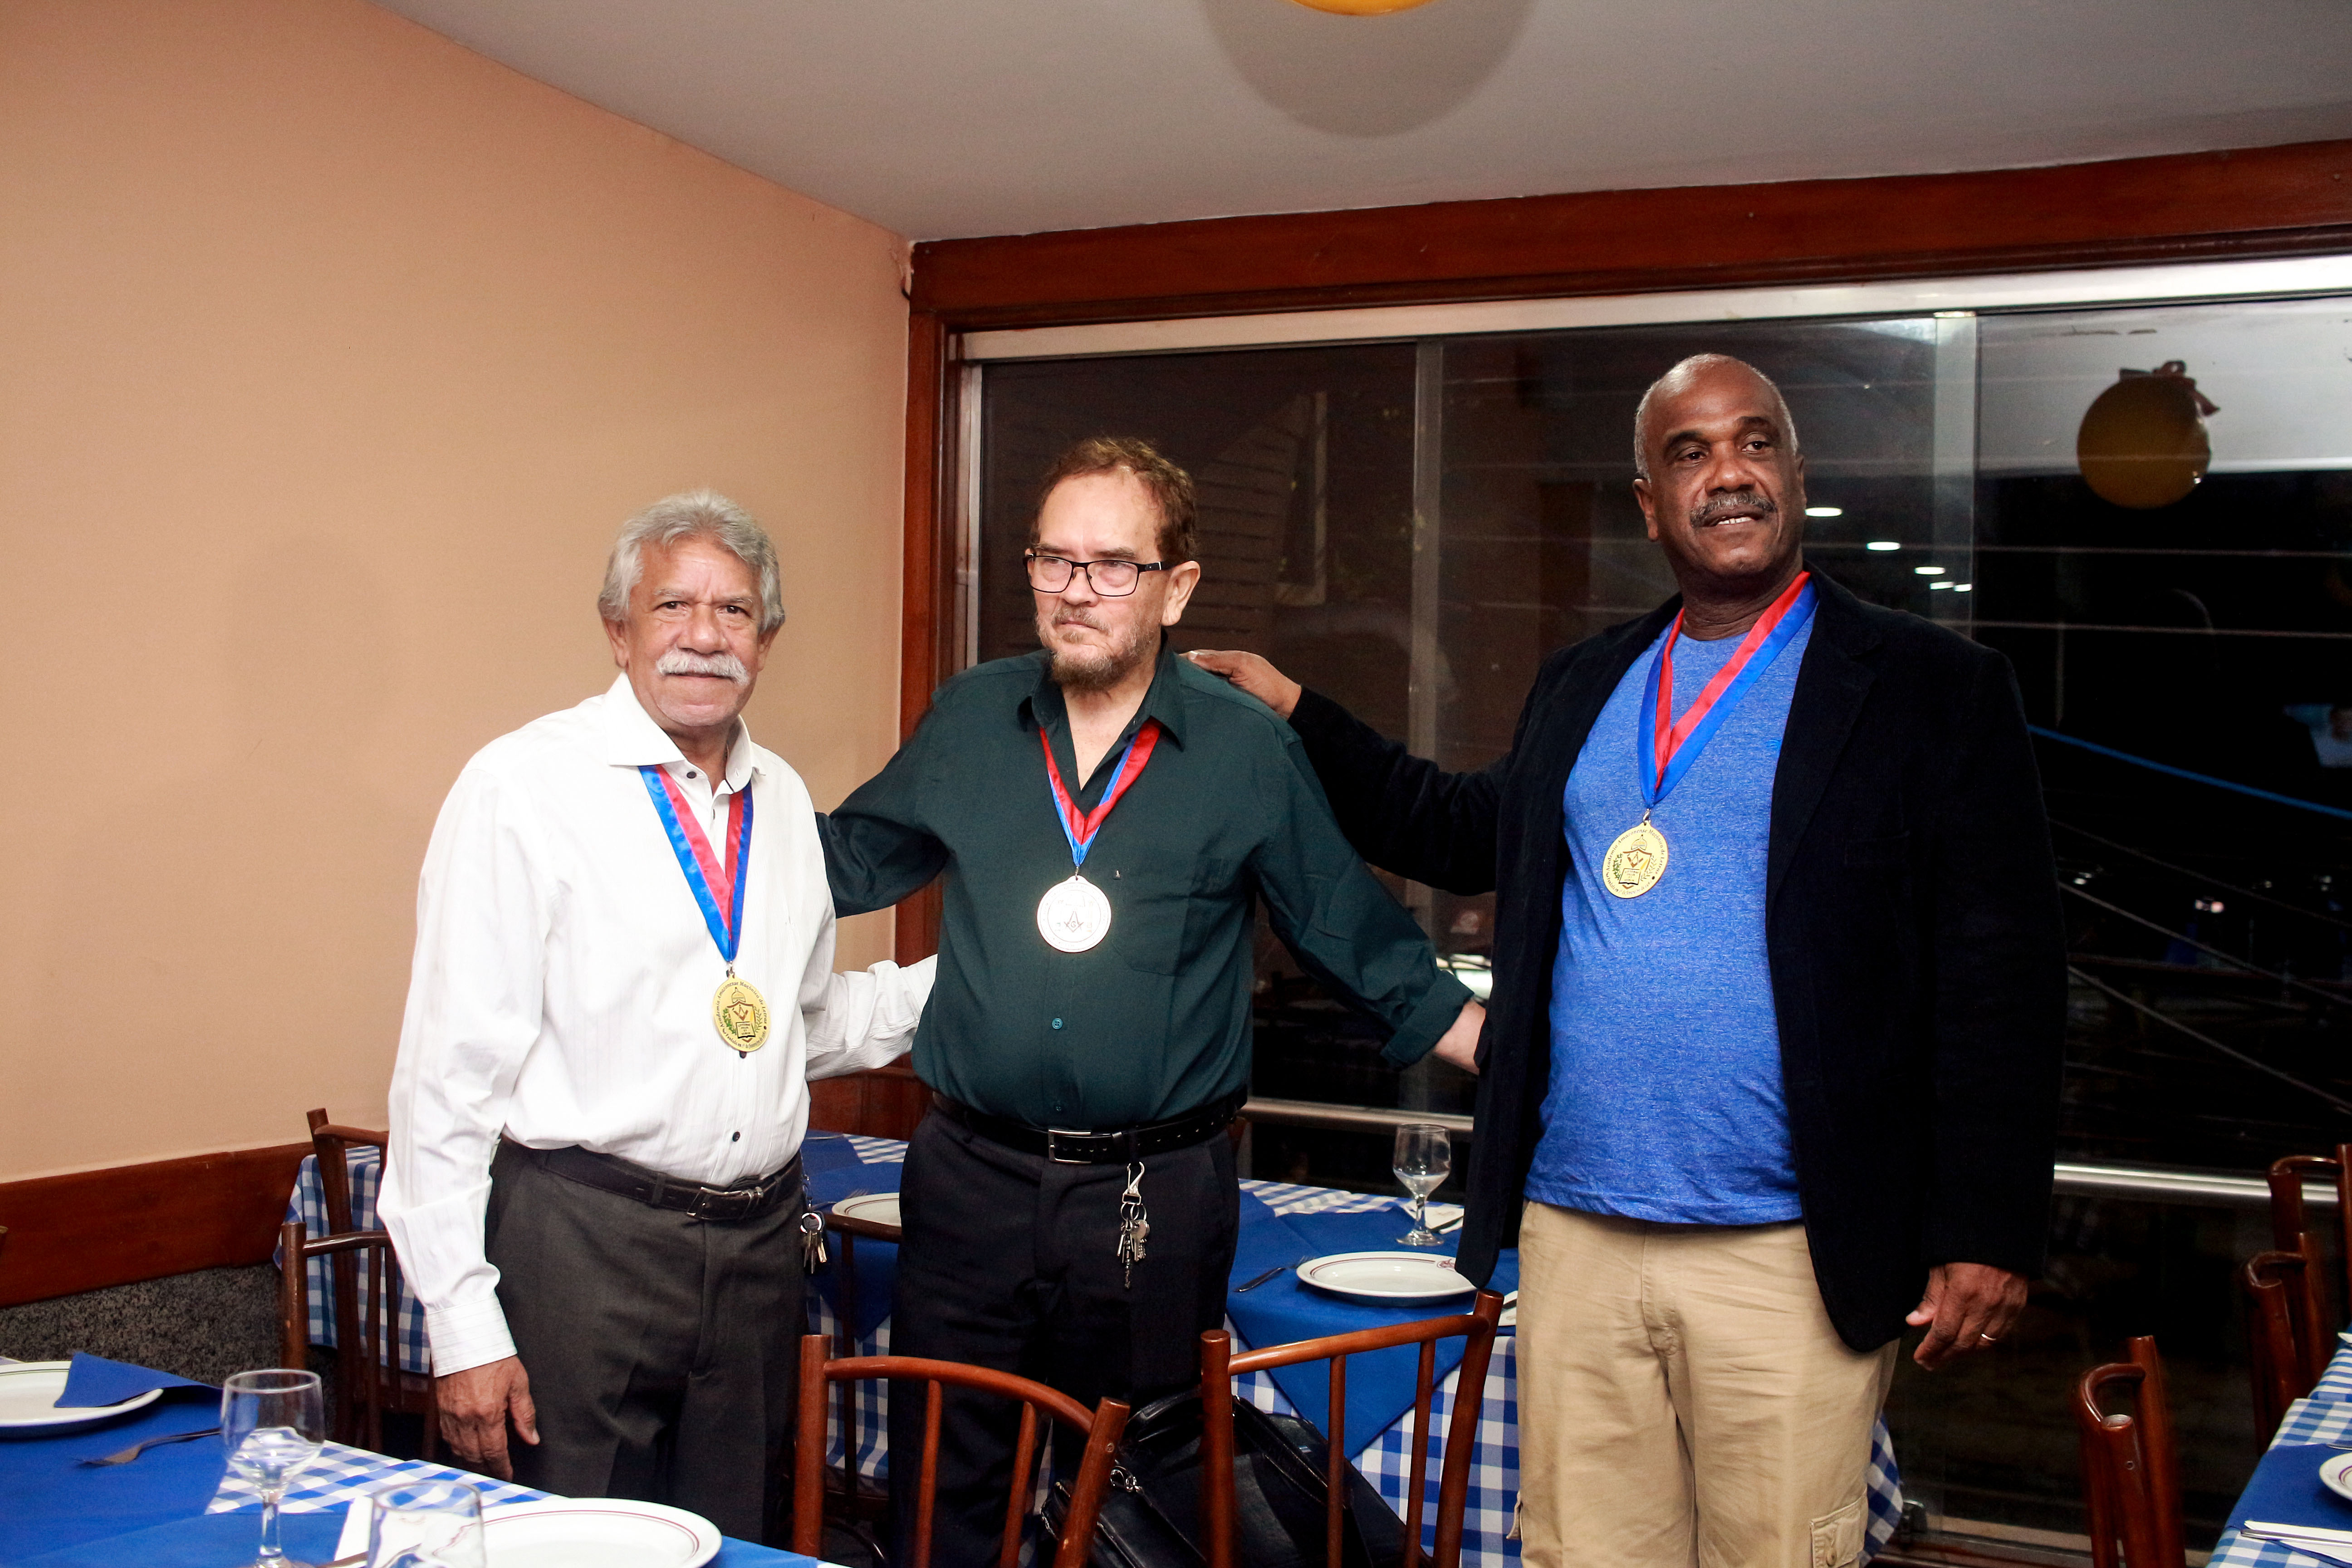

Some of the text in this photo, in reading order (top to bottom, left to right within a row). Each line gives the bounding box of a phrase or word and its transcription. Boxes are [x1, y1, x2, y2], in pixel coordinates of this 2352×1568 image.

[1606, 845, 1618, 871] Academia
[1655, 857, 1664, 874] Letras
[716, 1001, 724, 1027] Academia
